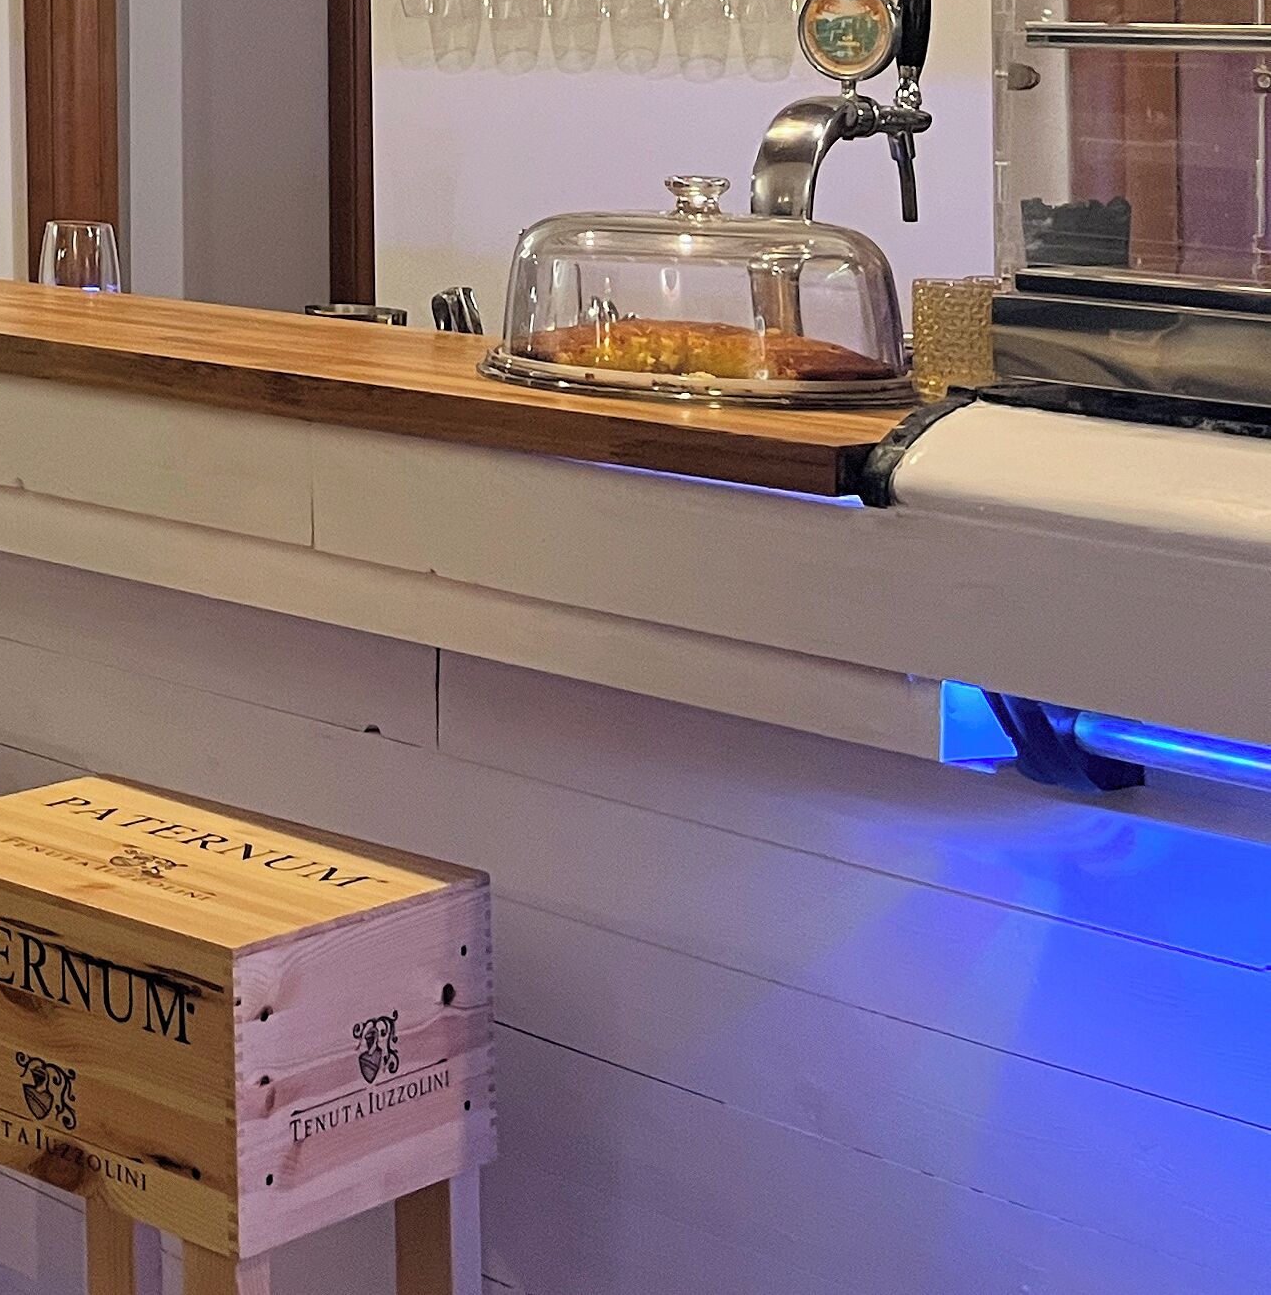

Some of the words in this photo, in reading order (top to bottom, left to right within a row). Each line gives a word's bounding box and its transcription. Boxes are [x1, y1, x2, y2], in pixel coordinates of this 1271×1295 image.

[42, 796, 374, 888] PATERNUM
[289, 1102, 364, 1143] TENUTA
[368, 1069, 450, 1115] IUZZOLINI
[35, 1128, 147, 1192] IUZZOLINI
